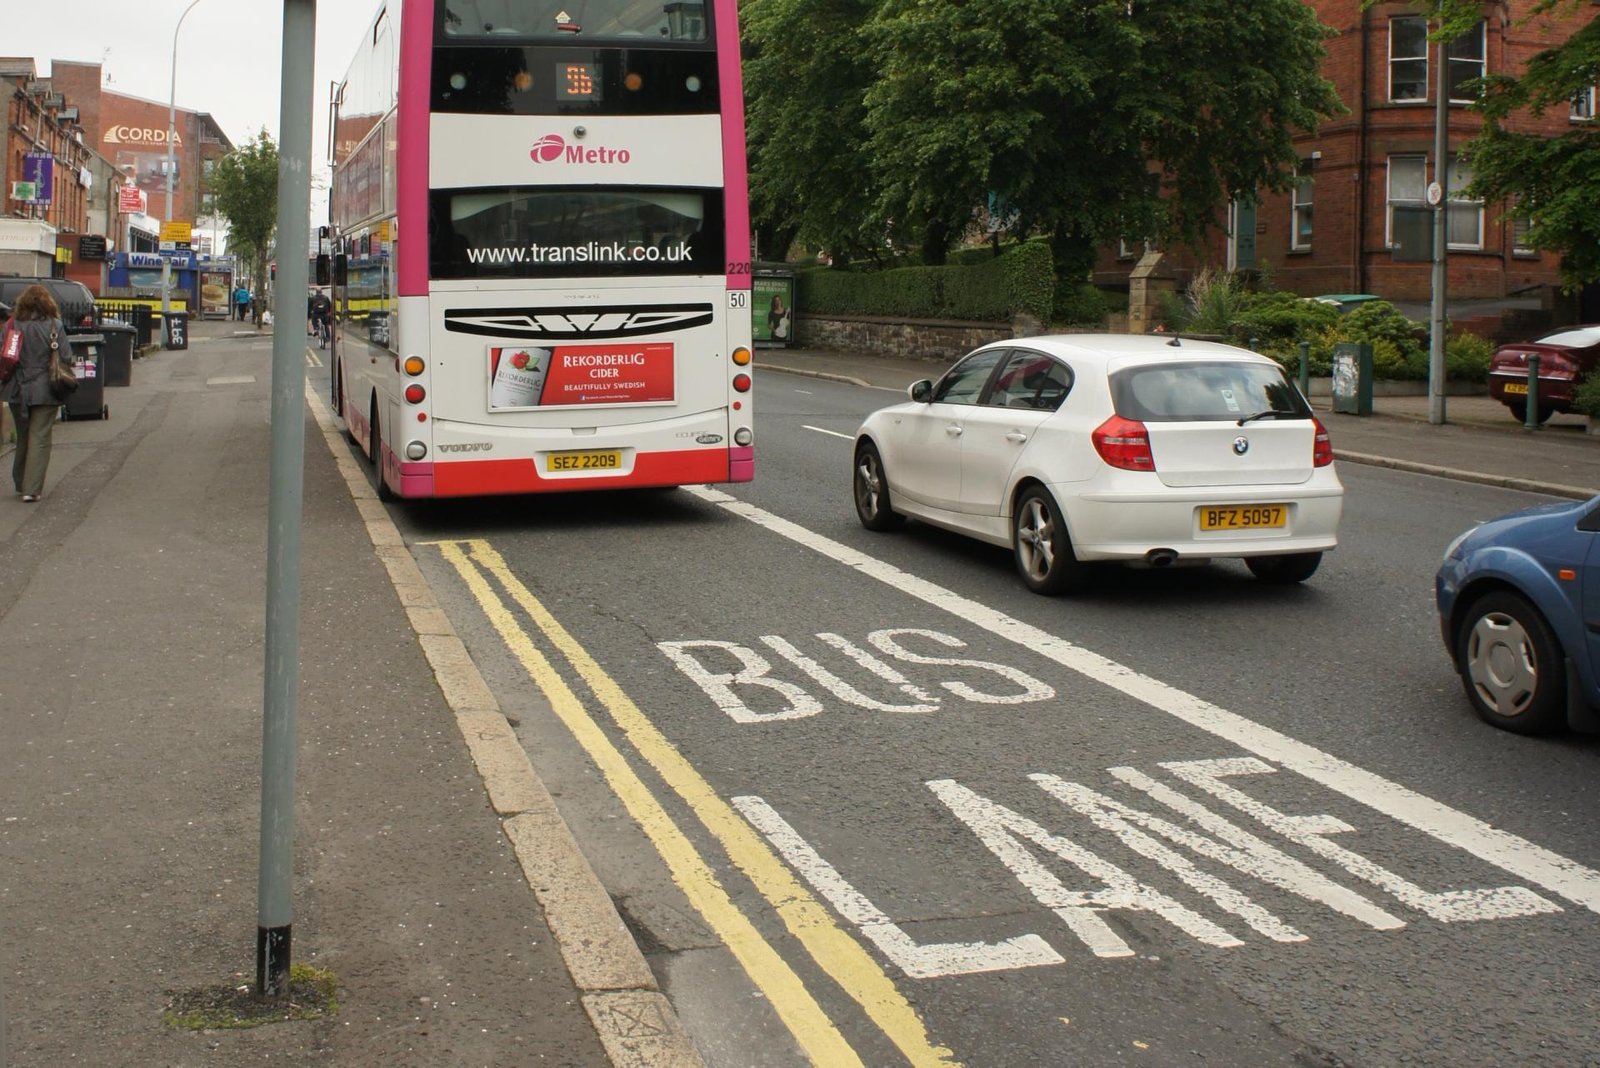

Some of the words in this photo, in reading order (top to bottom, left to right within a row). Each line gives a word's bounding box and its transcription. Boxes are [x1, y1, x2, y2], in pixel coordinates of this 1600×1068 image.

[117, 126, 182, 143] CORDIA
[566, 145, 630, 164] Metro
[466, 241, 693, 263] www.translink.co.uk
[728, 262, 749, 275] 220
[730, 293, 745, 308] 50
[171, 317, 184, 345] 397
[563, 353, 645, 367] REKORDERLIG
[590, 368, 619, 378] CIDER
[564, 383, 611, 392] BEAUTIFULLY
[613, 381, 646, 390] SWEDISH
[437, 442, 493, 453] VOLVO
[554, 456, 579, 469] SEZ
[582, 454, 616, 468] 2209
[1208, 510, 1237, 526] BFZ
[1242, 508, 1281, 525] 5097
[656, 628, 1055, 724] BUS
[731, 756, 1564, 979] LANE
